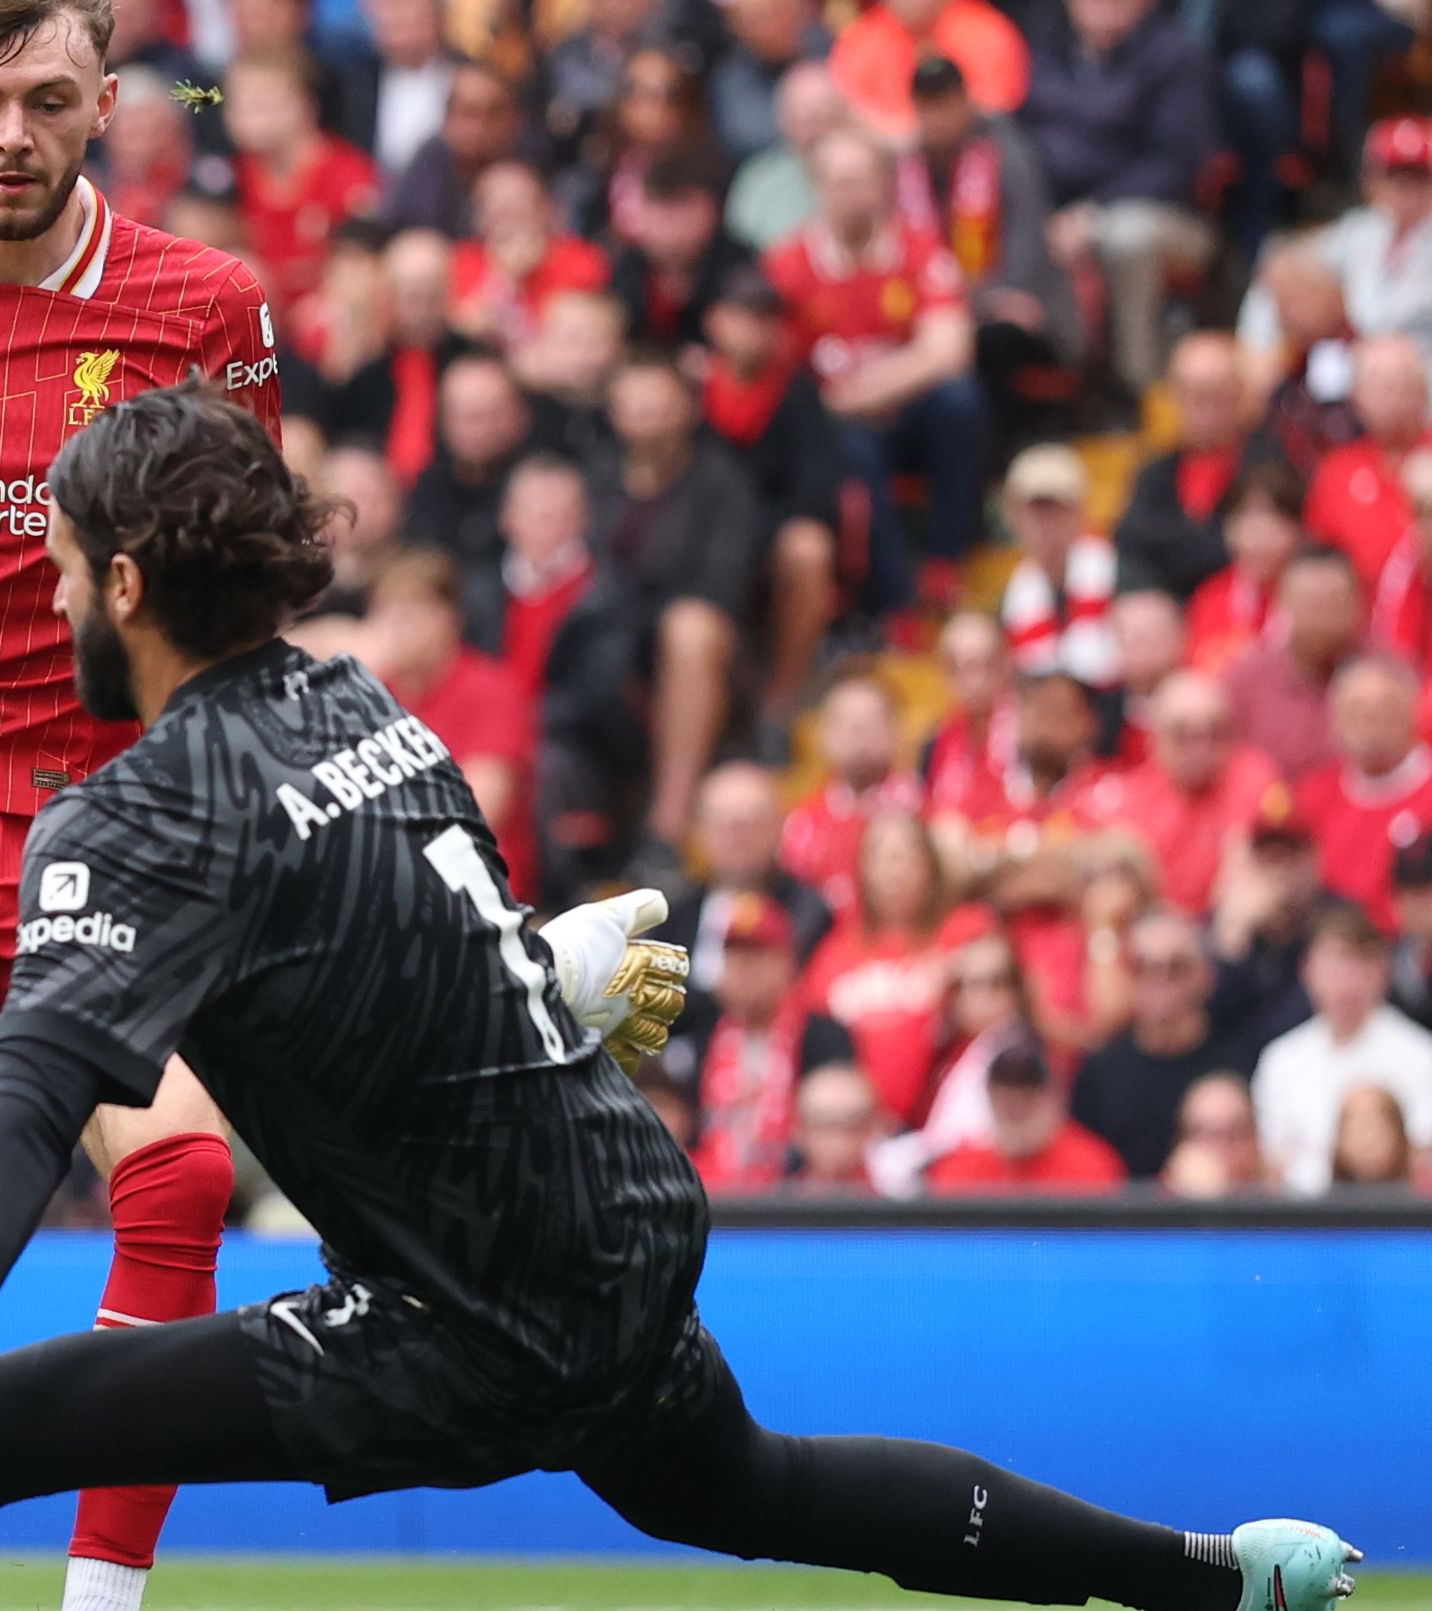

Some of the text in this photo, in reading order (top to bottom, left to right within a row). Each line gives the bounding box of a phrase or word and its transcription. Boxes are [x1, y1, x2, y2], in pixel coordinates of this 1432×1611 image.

[68, 408, 95, 425] L.F
[17, 911, 136, 953] xpedia
[423, 823, 568, 1064] 1
[963, 1485, 987, 1547] LFC
